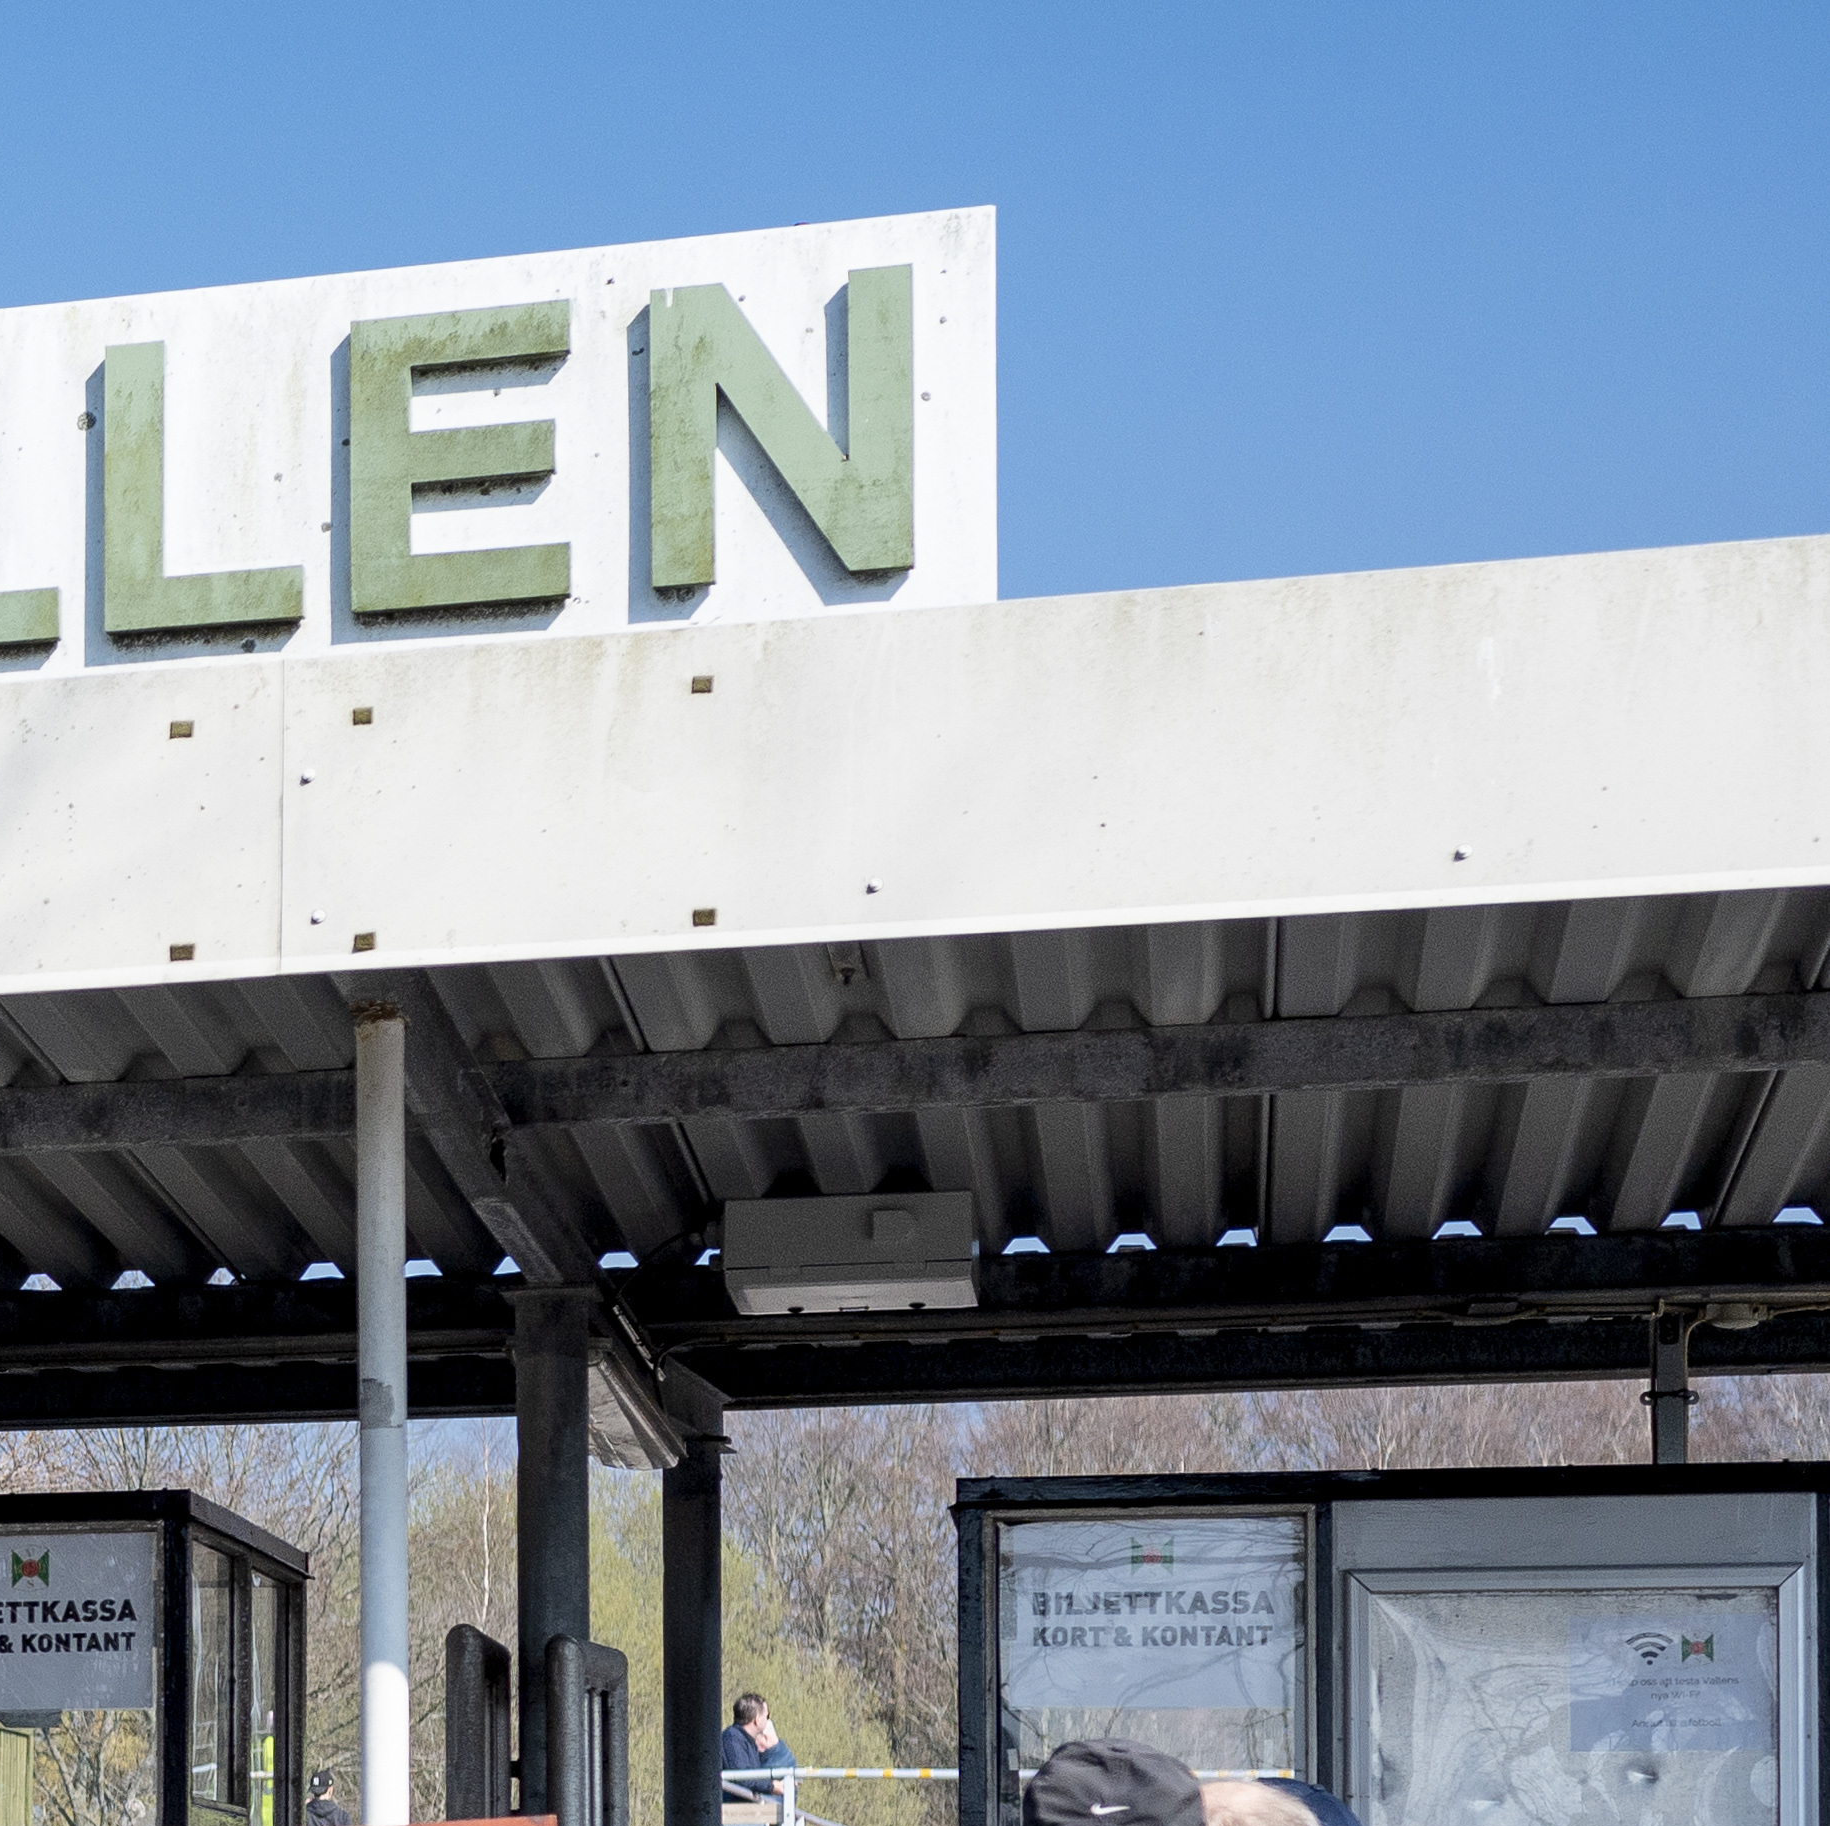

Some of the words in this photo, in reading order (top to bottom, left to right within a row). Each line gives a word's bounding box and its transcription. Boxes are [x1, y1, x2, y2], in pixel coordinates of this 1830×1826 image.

[1032, 1590, 1274, 1616] BILJETTKASSA
[21, 1632, 136, 1653] KONTANT
[1032, 1626, 1105, 1647] KORT
[1113, 1626, 1133, 1647] &
[1142, 1625, 1273, 1647] KONTANT
